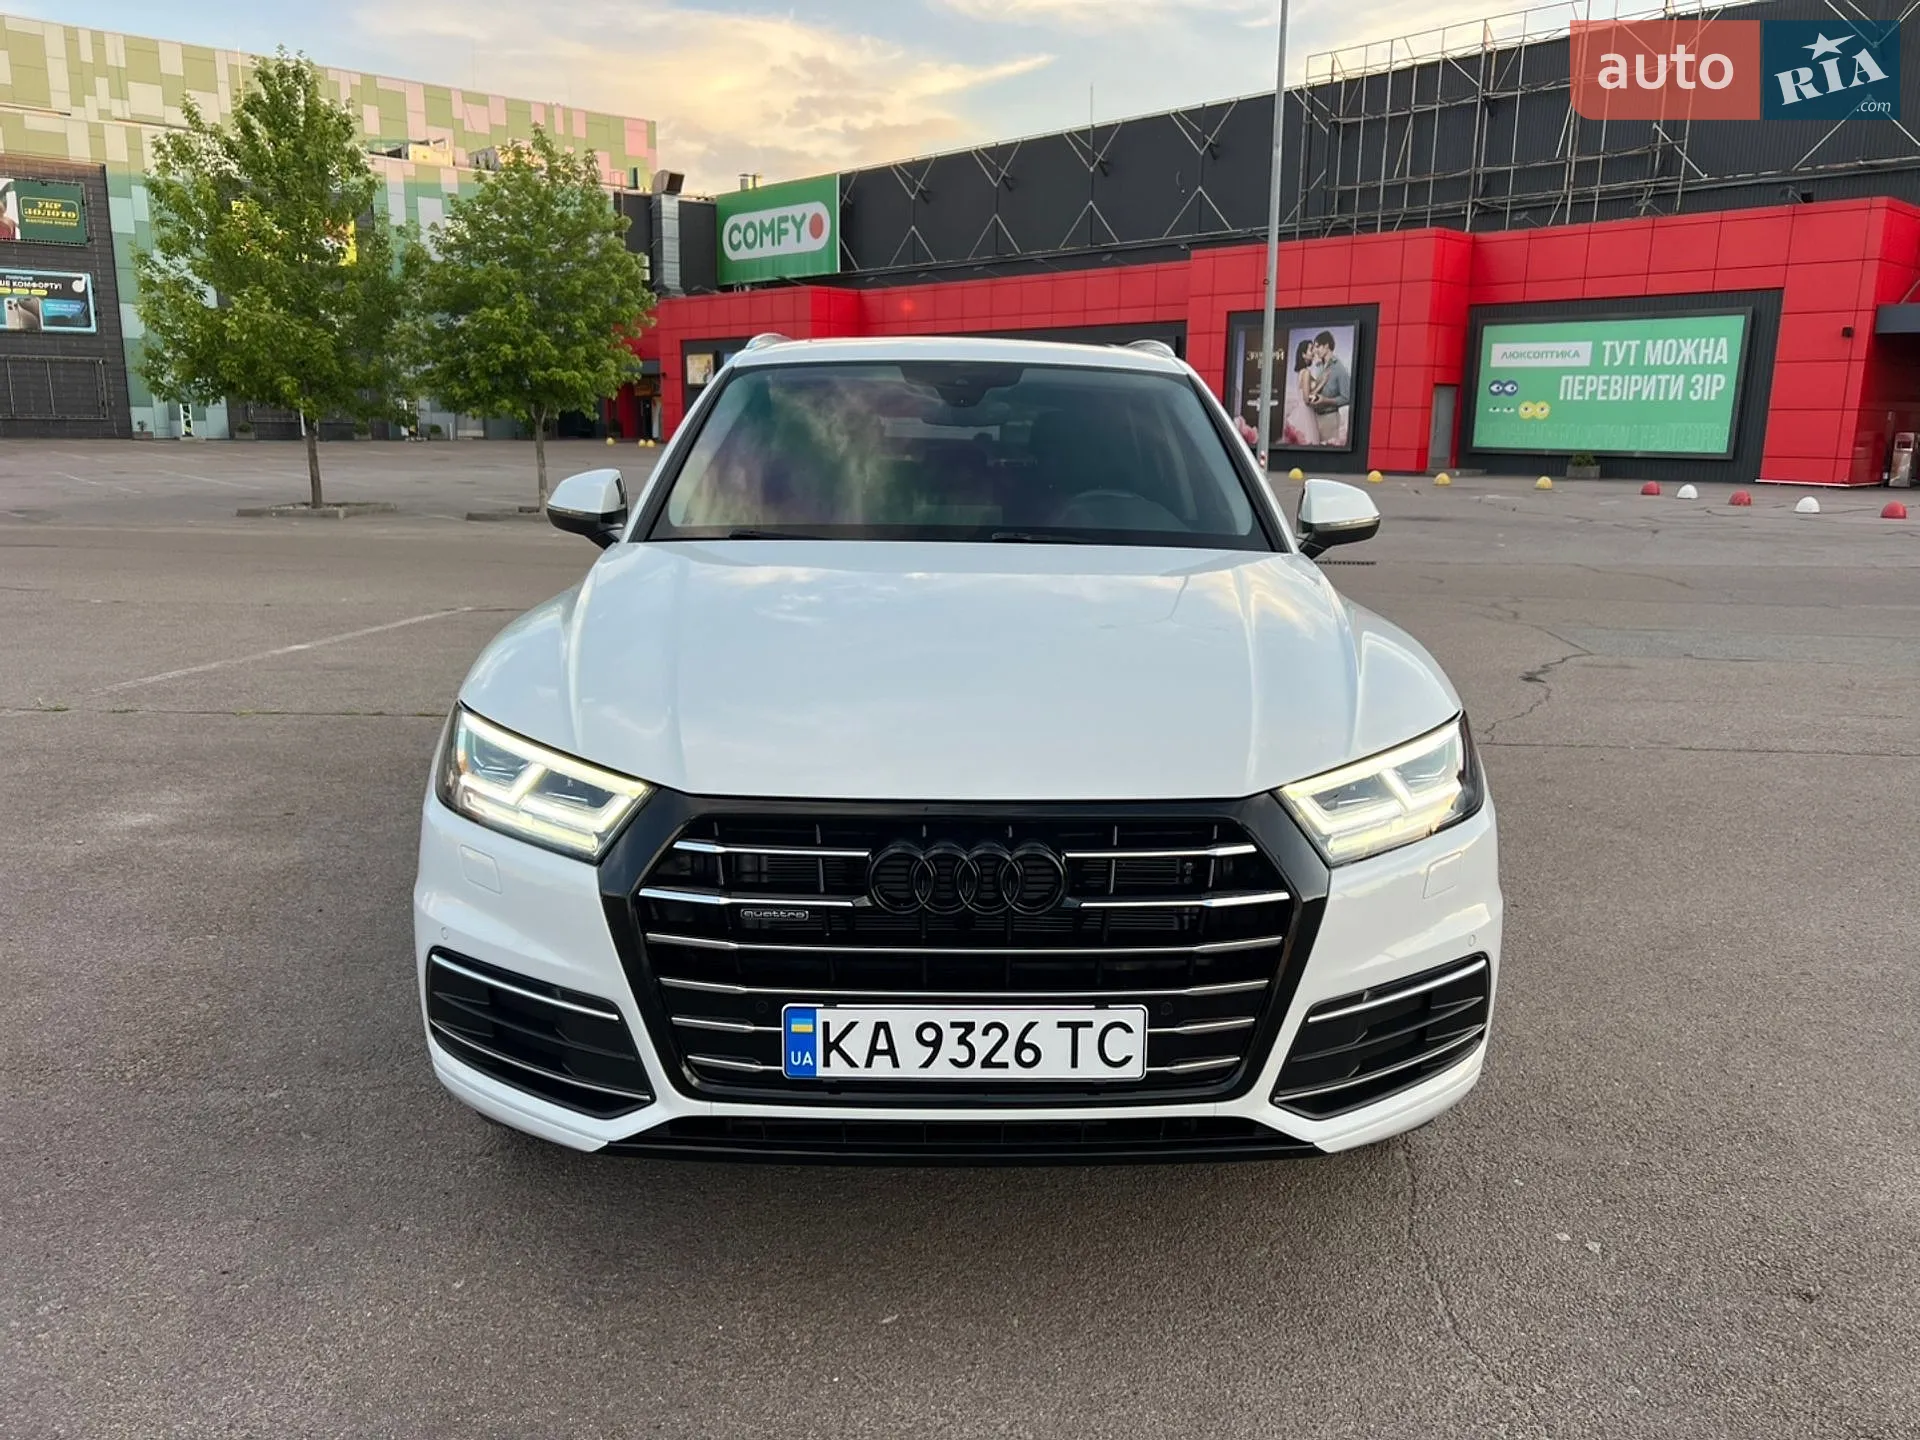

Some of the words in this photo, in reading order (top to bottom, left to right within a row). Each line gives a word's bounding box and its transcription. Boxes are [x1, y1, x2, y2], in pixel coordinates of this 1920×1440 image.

[728, 212, 807, 252] COMFY
[1602, 340, 1640, 367] ТУТ
[1644, 337, 1728, 366] МОЖНА
[1559, 374, 1684, 401] ПЕРЕВІРИТИ
[1688, 374, 1726, 401] ЗІР
[742, 909, 807, 919] quattro
[790, 1051, 813, 1066] UA
[822, 1020, 900, 1068] KA
[914, 1020, 1042, 1069] 9326
[1056, 1020, 1135, 1068] TC
